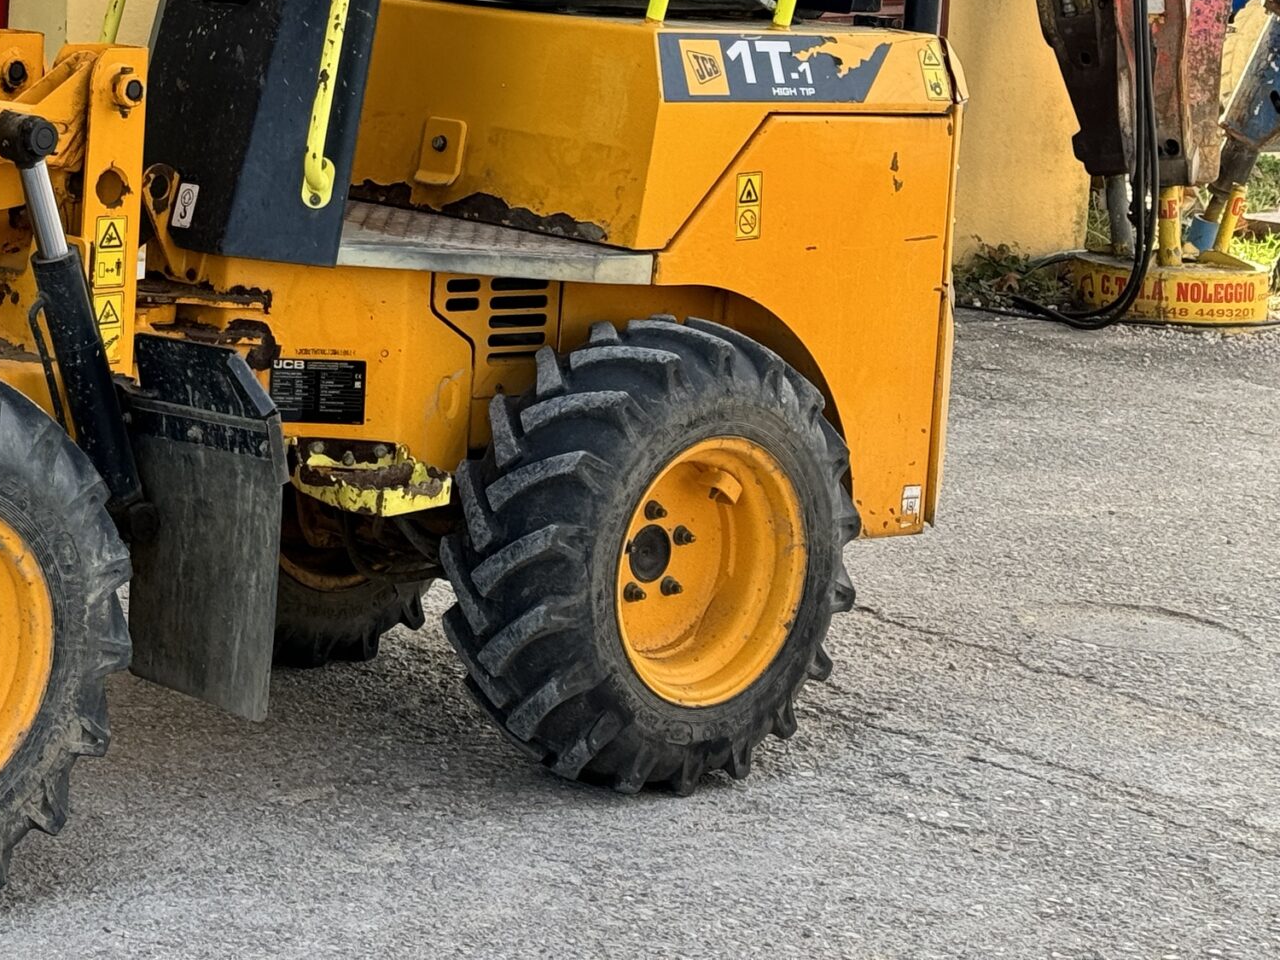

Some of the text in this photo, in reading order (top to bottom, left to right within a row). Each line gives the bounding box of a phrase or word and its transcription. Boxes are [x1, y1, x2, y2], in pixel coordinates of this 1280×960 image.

[692, 53, 720, 81] JCB
[772, 87, 815, 96] HIGH TIP
[1176, 281, 1255, 304] NOLEGGIO
[1195, 307, 1255, 318] 4493201
[273, 359, 305, 369] JCB
